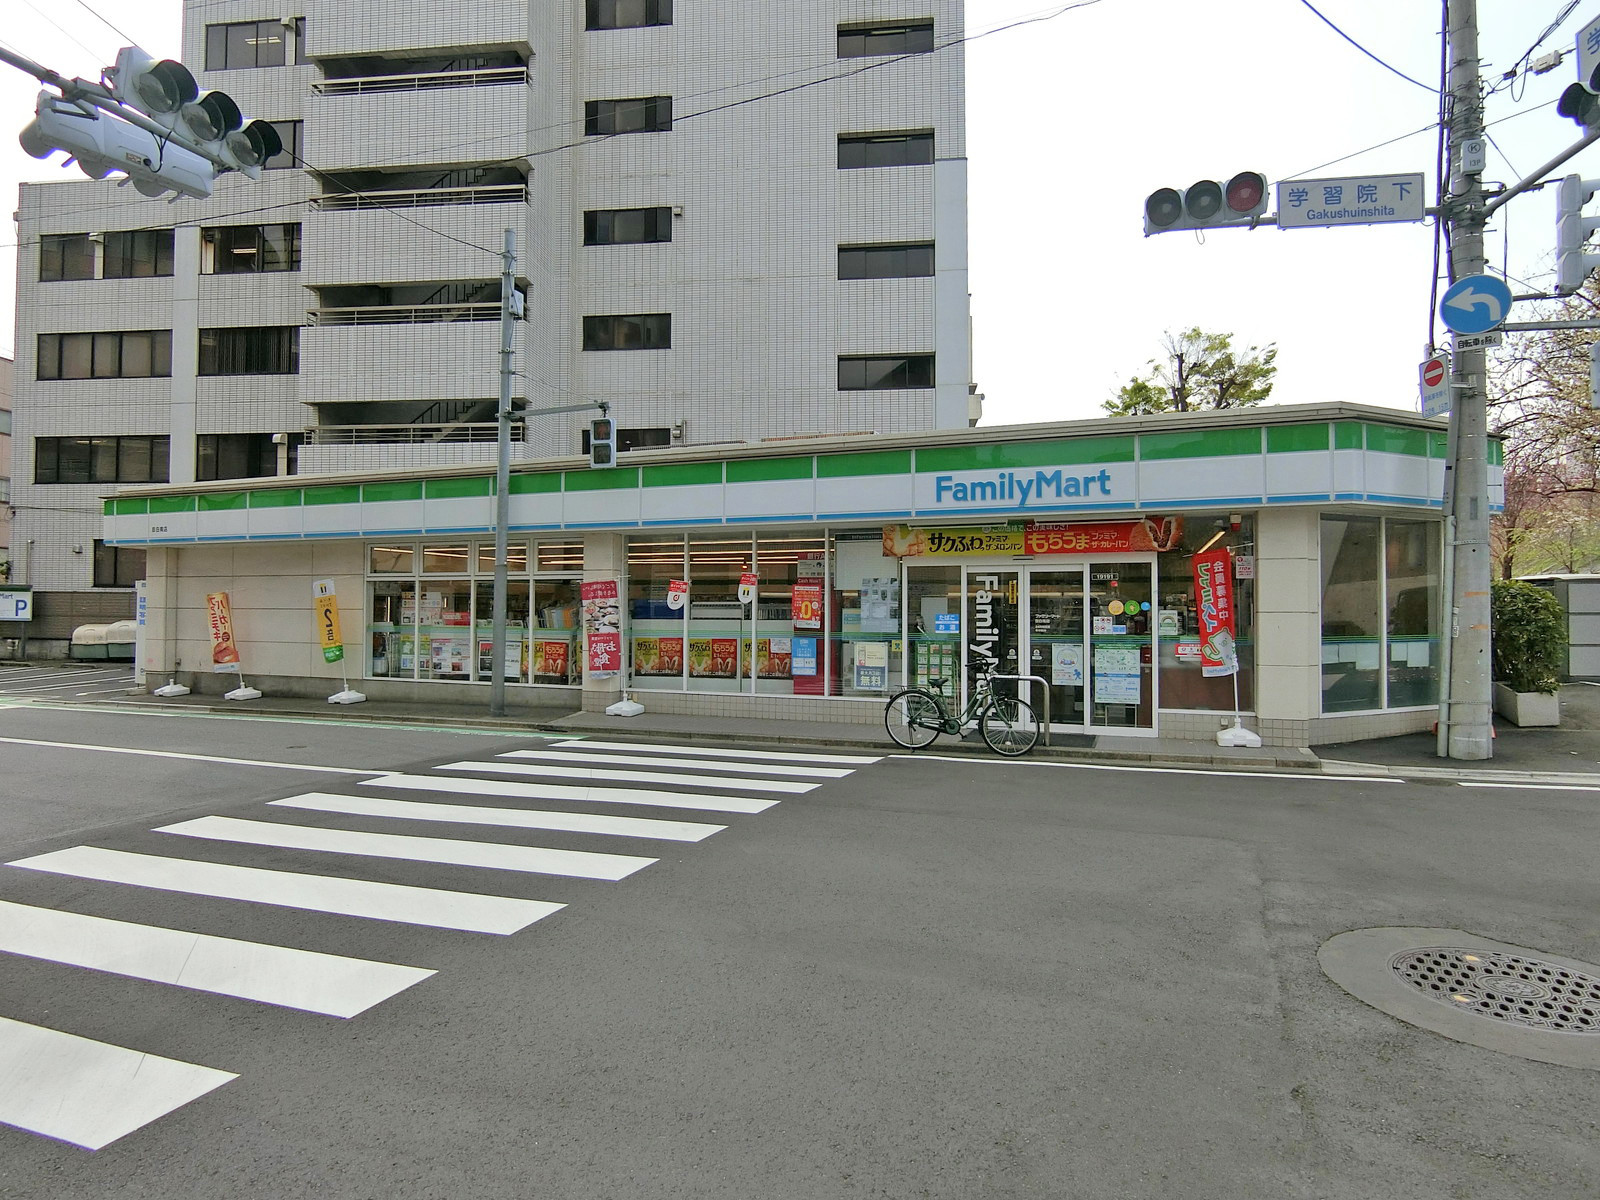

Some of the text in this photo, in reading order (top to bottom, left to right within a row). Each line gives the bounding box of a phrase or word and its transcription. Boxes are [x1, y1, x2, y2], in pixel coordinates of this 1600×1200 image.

[1288, 182, 1413, 208] 学習院下
[1306, 206, 1396, 220] Gakushuinshita
[1457, 335, 1498, 350] 自転車を除く
[935, 468, 1111, 507] FamilyMart
[1027, 532, 1090, 552] もちうま
[1091, 539, 1129, 549] ザ・カレーパン
[15, 599, 28, 617] P
[860, 675, 881, 687] 無料
